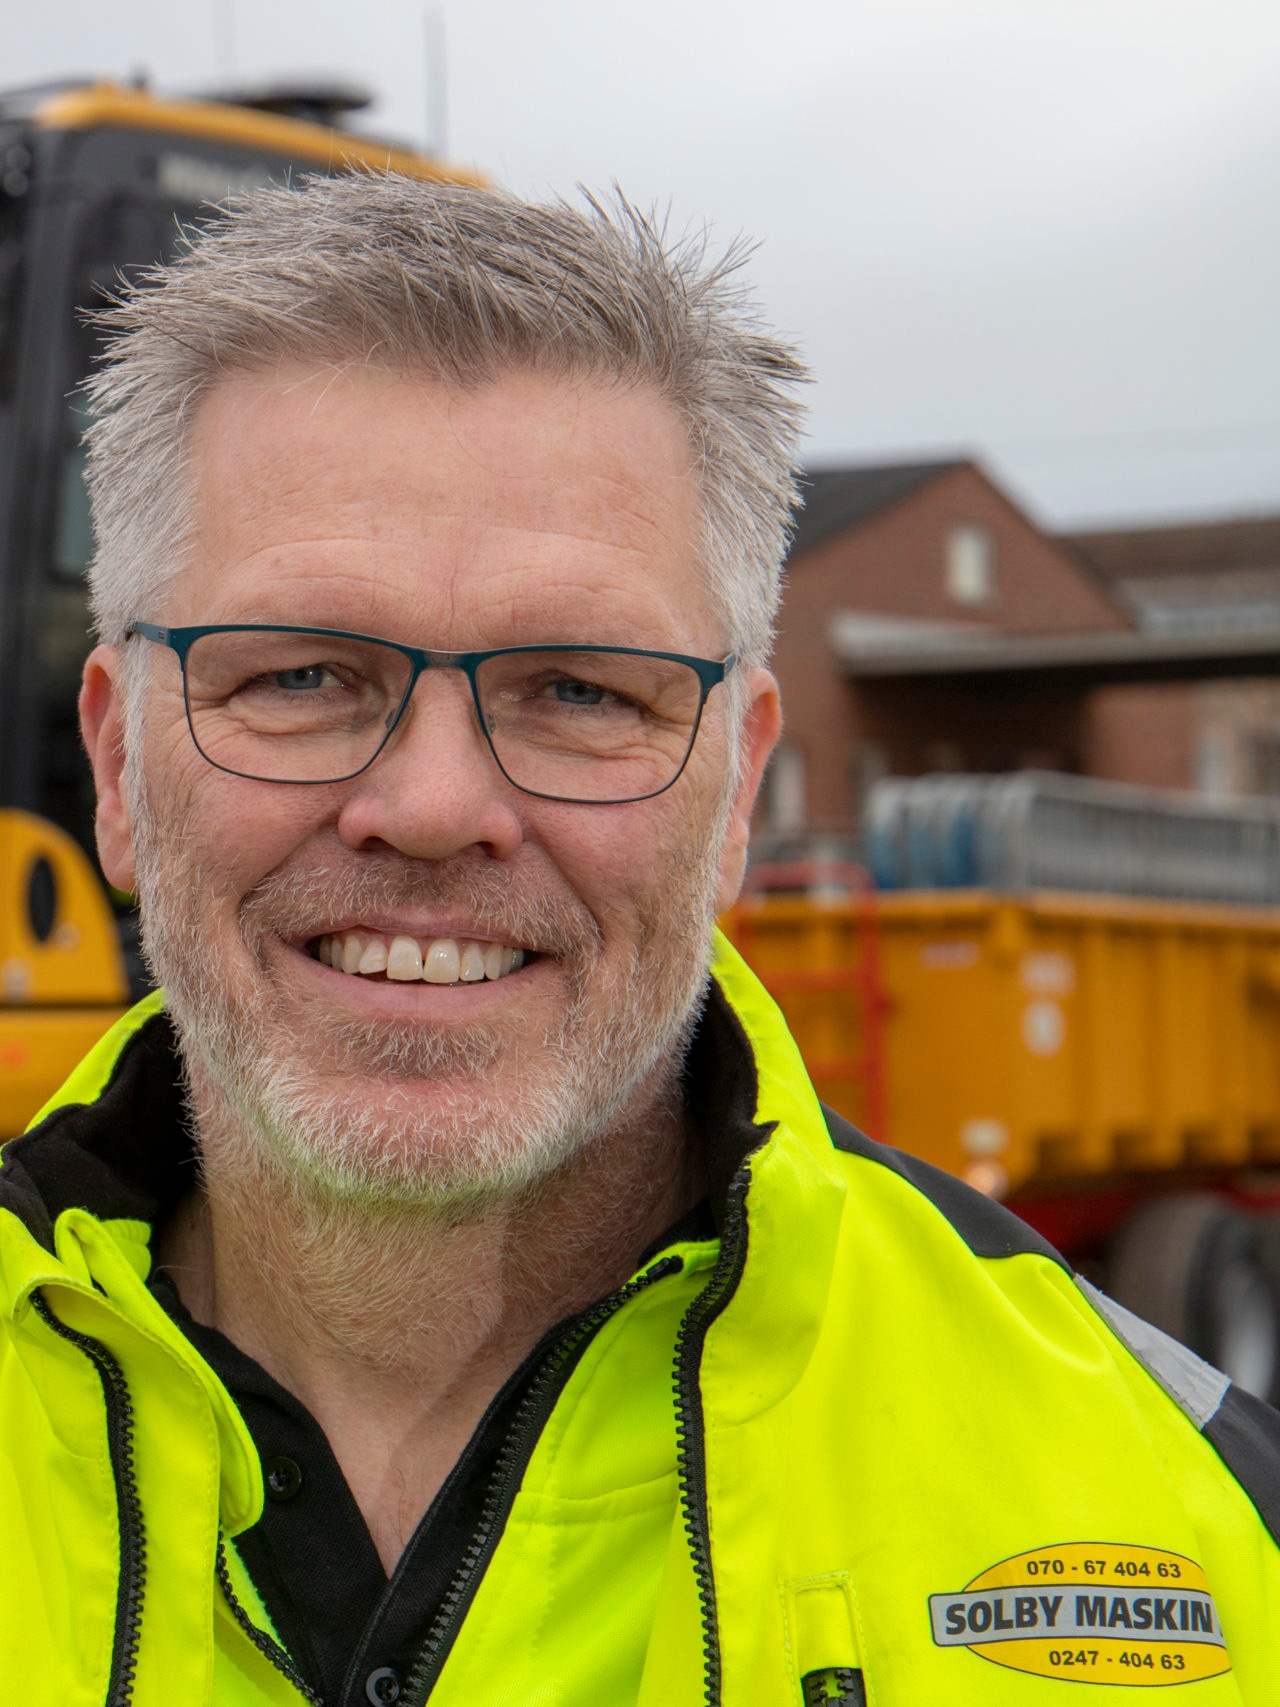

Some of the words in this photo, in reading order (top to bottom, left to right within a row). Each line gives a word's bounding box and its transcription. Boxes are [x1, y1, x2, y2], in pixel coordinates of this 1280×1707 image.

[1026, 1559, 1065, 1576] 070
[1083, 1559, 1106, 1575] 67
[1114, 1561, 1151, 1577] 404
[1157, 1562, 1182, 1579] 63
[945, 1595, 1064, 1636] SOLBY
[1075, 1595, 1214, 1634] MASKIN
[1049, 1650, 1099, 1666] 0247
[1119, 1651, 1155, 1669] 404
[1160, 1654, 1186, 1670] 63
